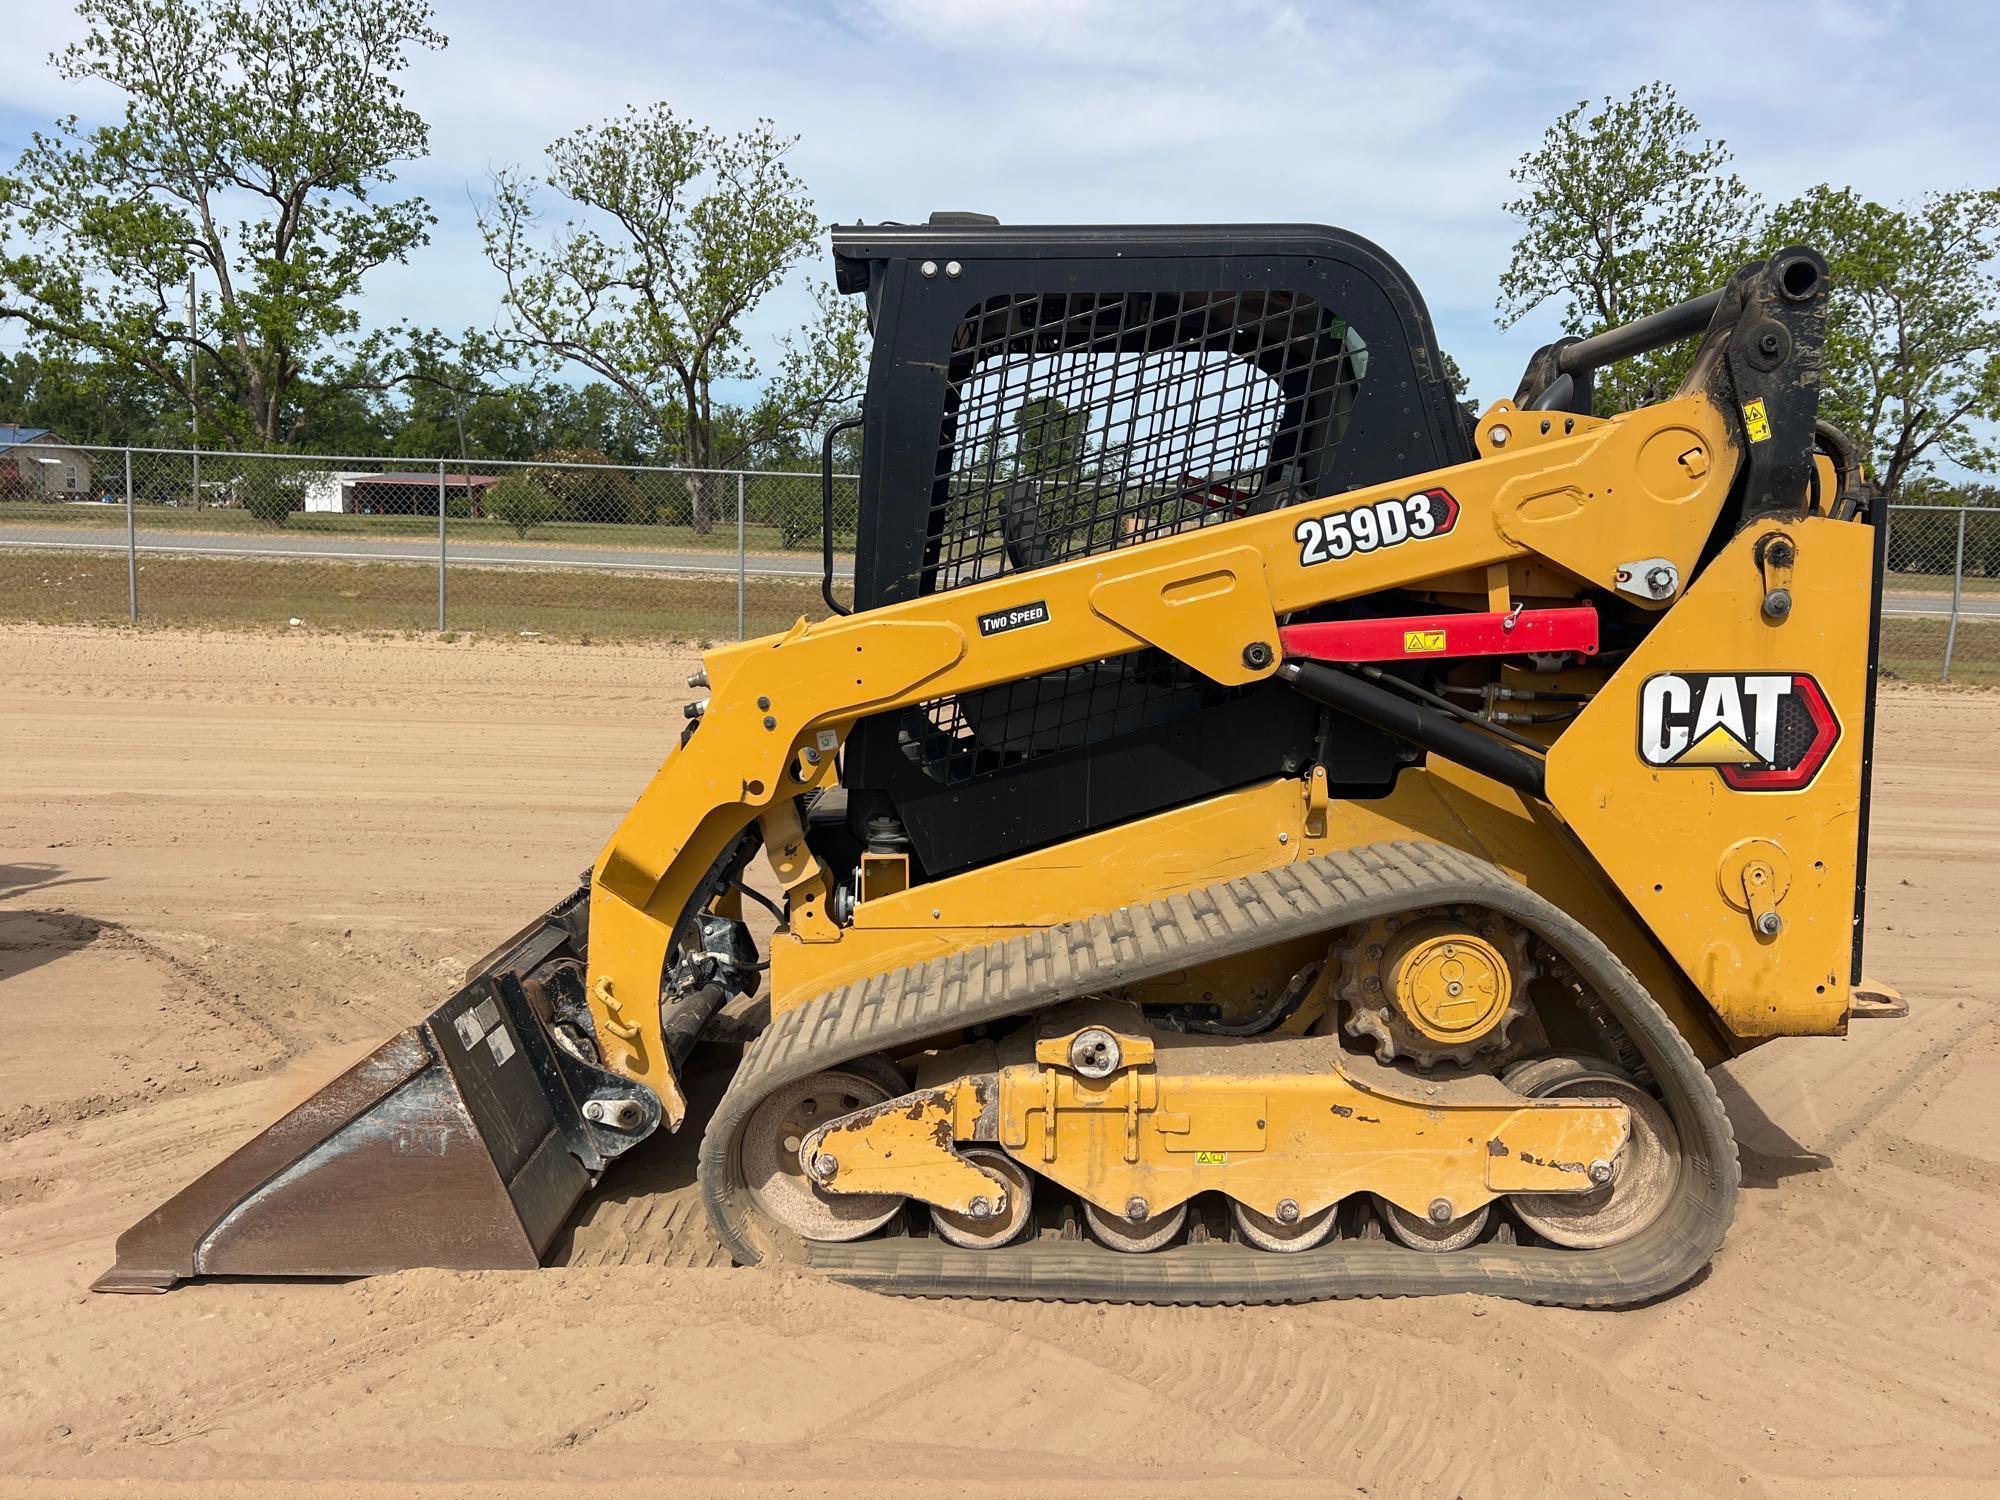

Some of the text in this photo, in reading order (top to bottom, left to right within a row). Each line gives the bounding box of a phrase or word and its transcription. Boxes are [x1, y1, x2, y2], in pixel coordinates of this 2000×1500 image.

[1297, 494, 1435, 564] 259D3
[983, 607, 1043, 631] TWO SPEED
[1642, 675, 1792, 764] CAT
